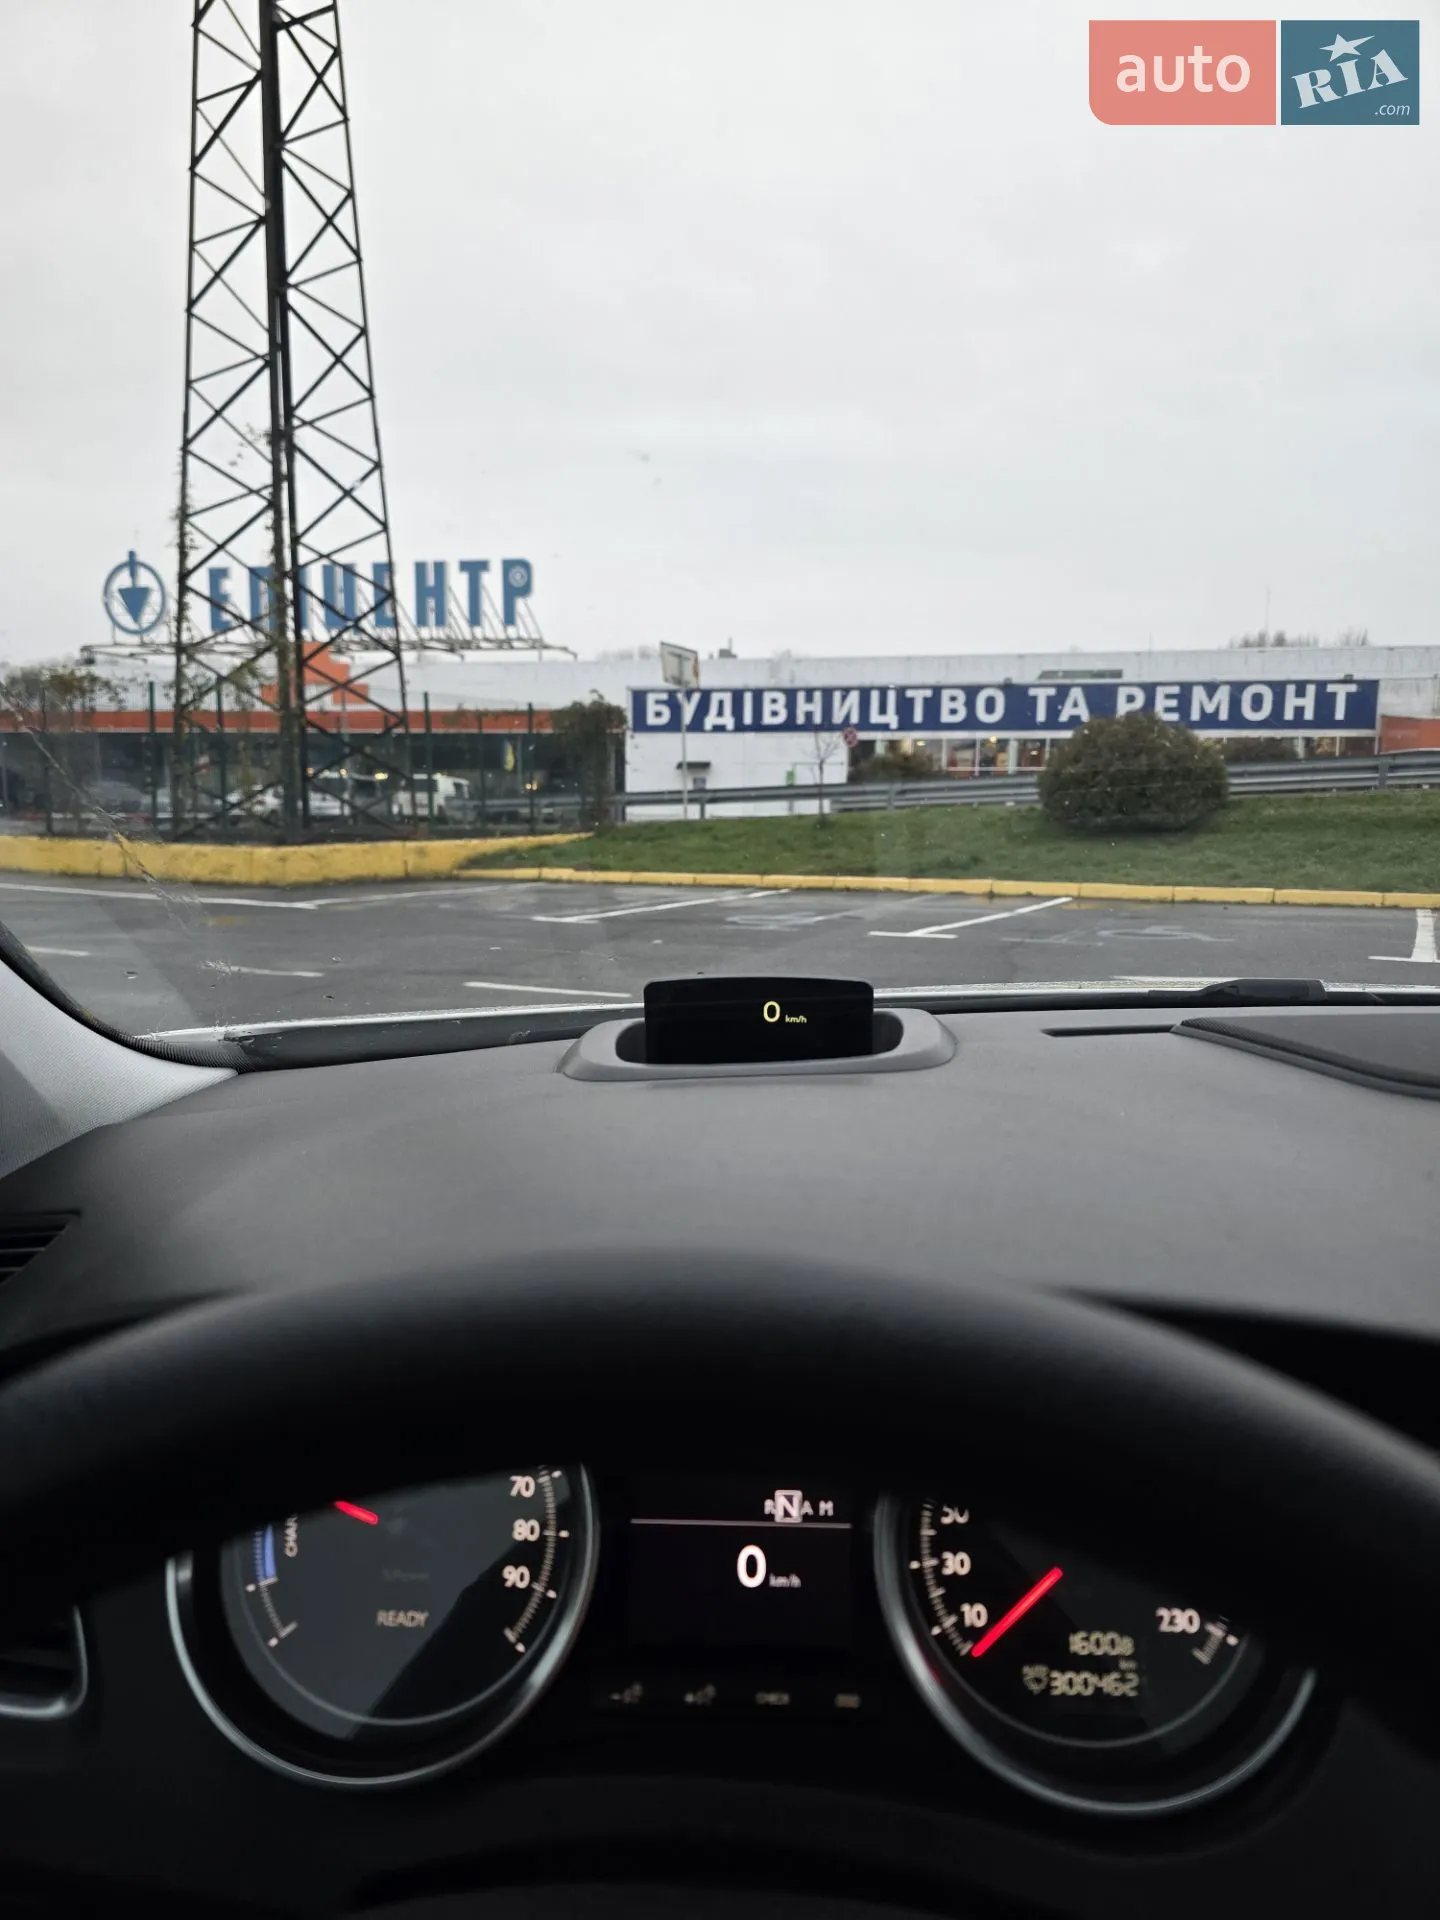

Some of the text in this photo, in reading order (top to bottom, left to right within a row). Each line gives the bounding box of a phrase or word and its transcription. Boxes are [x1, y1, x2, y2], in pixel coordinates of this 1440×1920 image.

[645, 683, 1358, 731] БУДІВНИЦТВО ТА РЕМОНТ
[763, 1000, 808, 1024] 0 km/h
[509, 1475, 536, 1498] 70
[779, 1494, 800, 1519] N
[818, 1500, 834, 1517] M
[512, 1518, 541, 1541] 80
[736, 1544, 767, 1588] 0
[941, 1551, 972, 1576] 30
[502, 1565, 531, 1589] 90
[376, 1610, 429, 1628] READY
[960, 1602, 989, 1628] 10
[1155, 1606, 1201, 1634] 230
